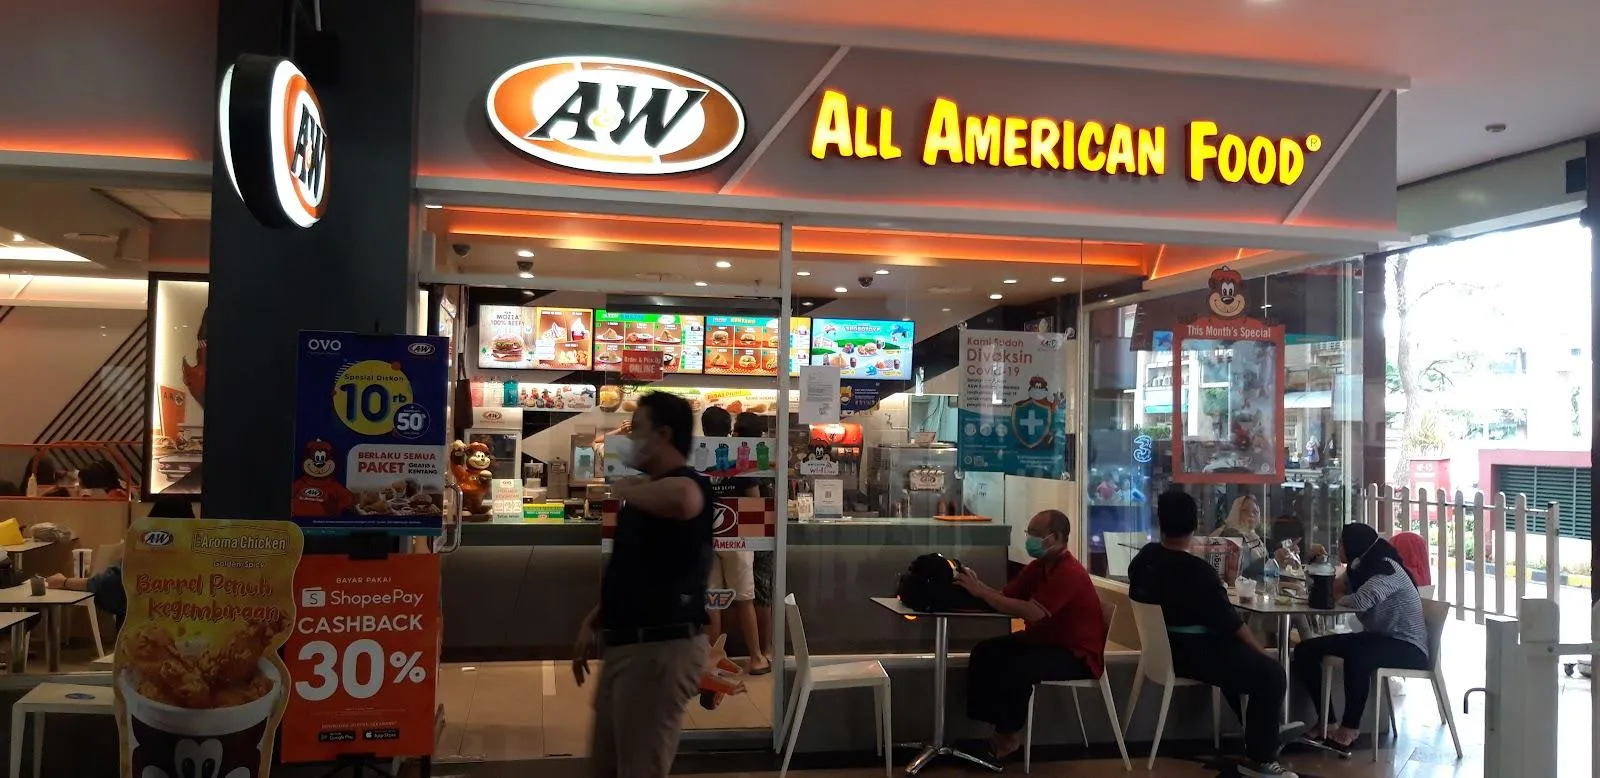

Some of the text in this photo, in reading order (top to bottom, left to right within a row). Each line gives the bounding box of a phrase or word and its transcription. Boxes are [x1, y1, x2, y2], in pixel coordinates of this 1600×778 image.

[526, 81, 709, 148] A&W
[811, 90, 902, 159] ALL
[922, 97, 1165, 176] AMERICAN
[1187, 326, 1271, 338] This Month's Special
[308, 339, 342, 351] OVO
[967, 337, 992, 346] Kami
[966, 349, 1033, 364] Divaksin
[344, 373, 373, 381] Spesial
[340, 383, 388, 423] 10
[392, 394, 407, 403] rb
[358, 452, 436, 461] BERLAKU SEMUA
[358, 462, 406, 474] PAKET
[201, 536, 239, 549] Aroma
[240, 536, 287, 551] Chicken
[713, 539, 747, 550] AMERIKA
[137, 573, 273, 599] Barrel Penuh
[330, 588, 424, 608] ShopeePay
[297, 614, 423, 634] CASHBACK
[295, 638, 427, 701] 30%
